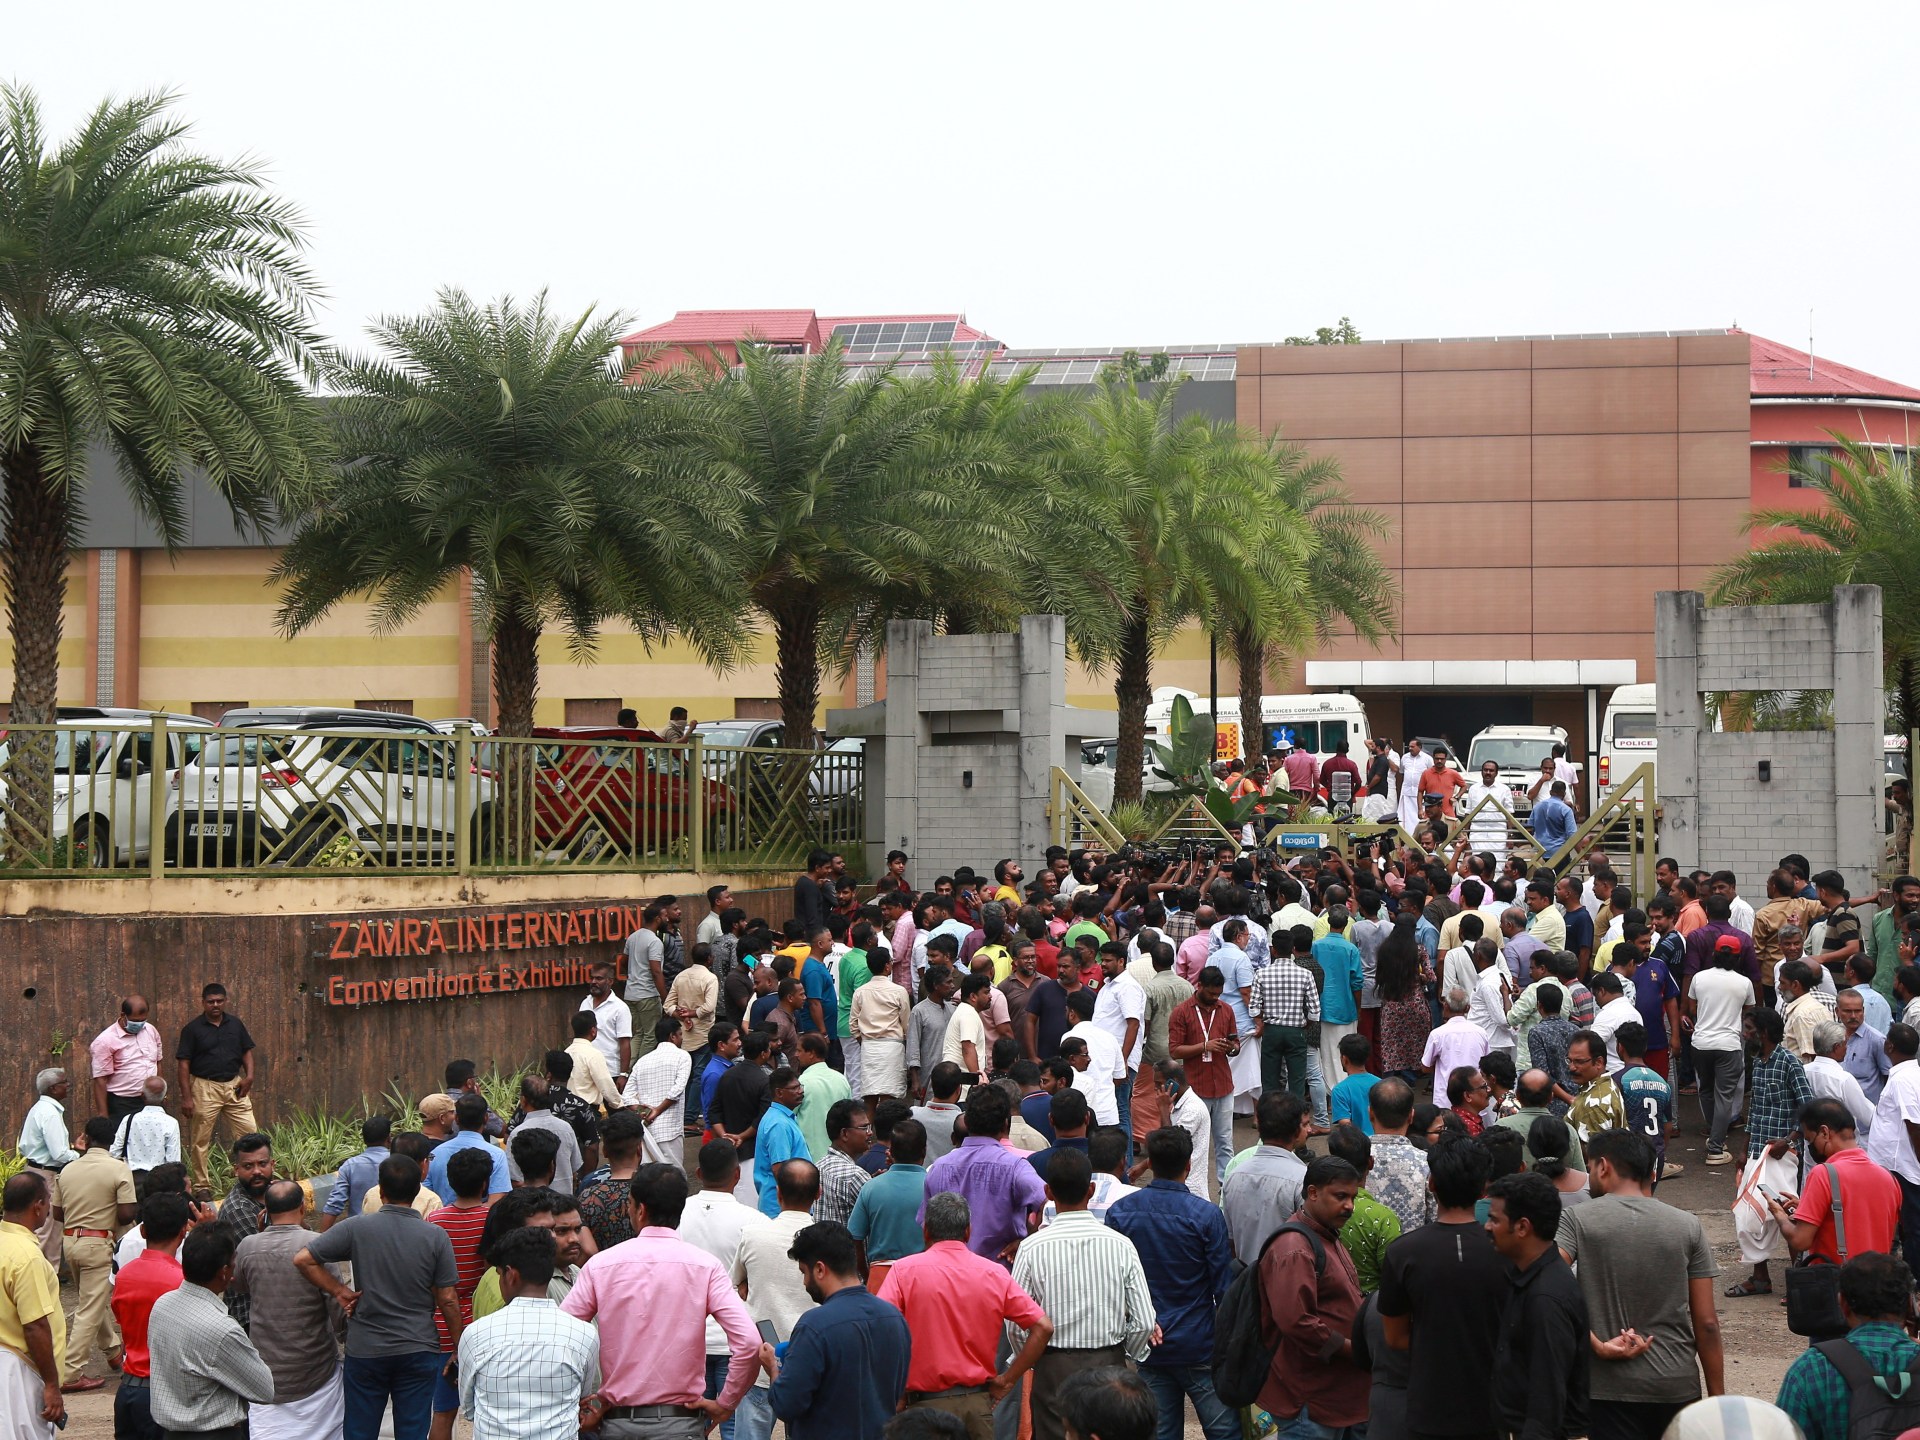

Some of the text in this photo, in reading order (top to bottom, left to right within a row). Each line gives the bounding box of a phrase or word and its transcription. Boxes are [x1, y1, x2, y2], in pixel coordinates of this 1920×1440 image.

[328, 905, 642, 959] ZAMRA INTERNATION
[328, 967, 474, 1005] Convention
[477, 965, 494, 993] &
[499, 957, 594, 991] Exhibitio
[1643, 1096, 1659, 1136] 3
